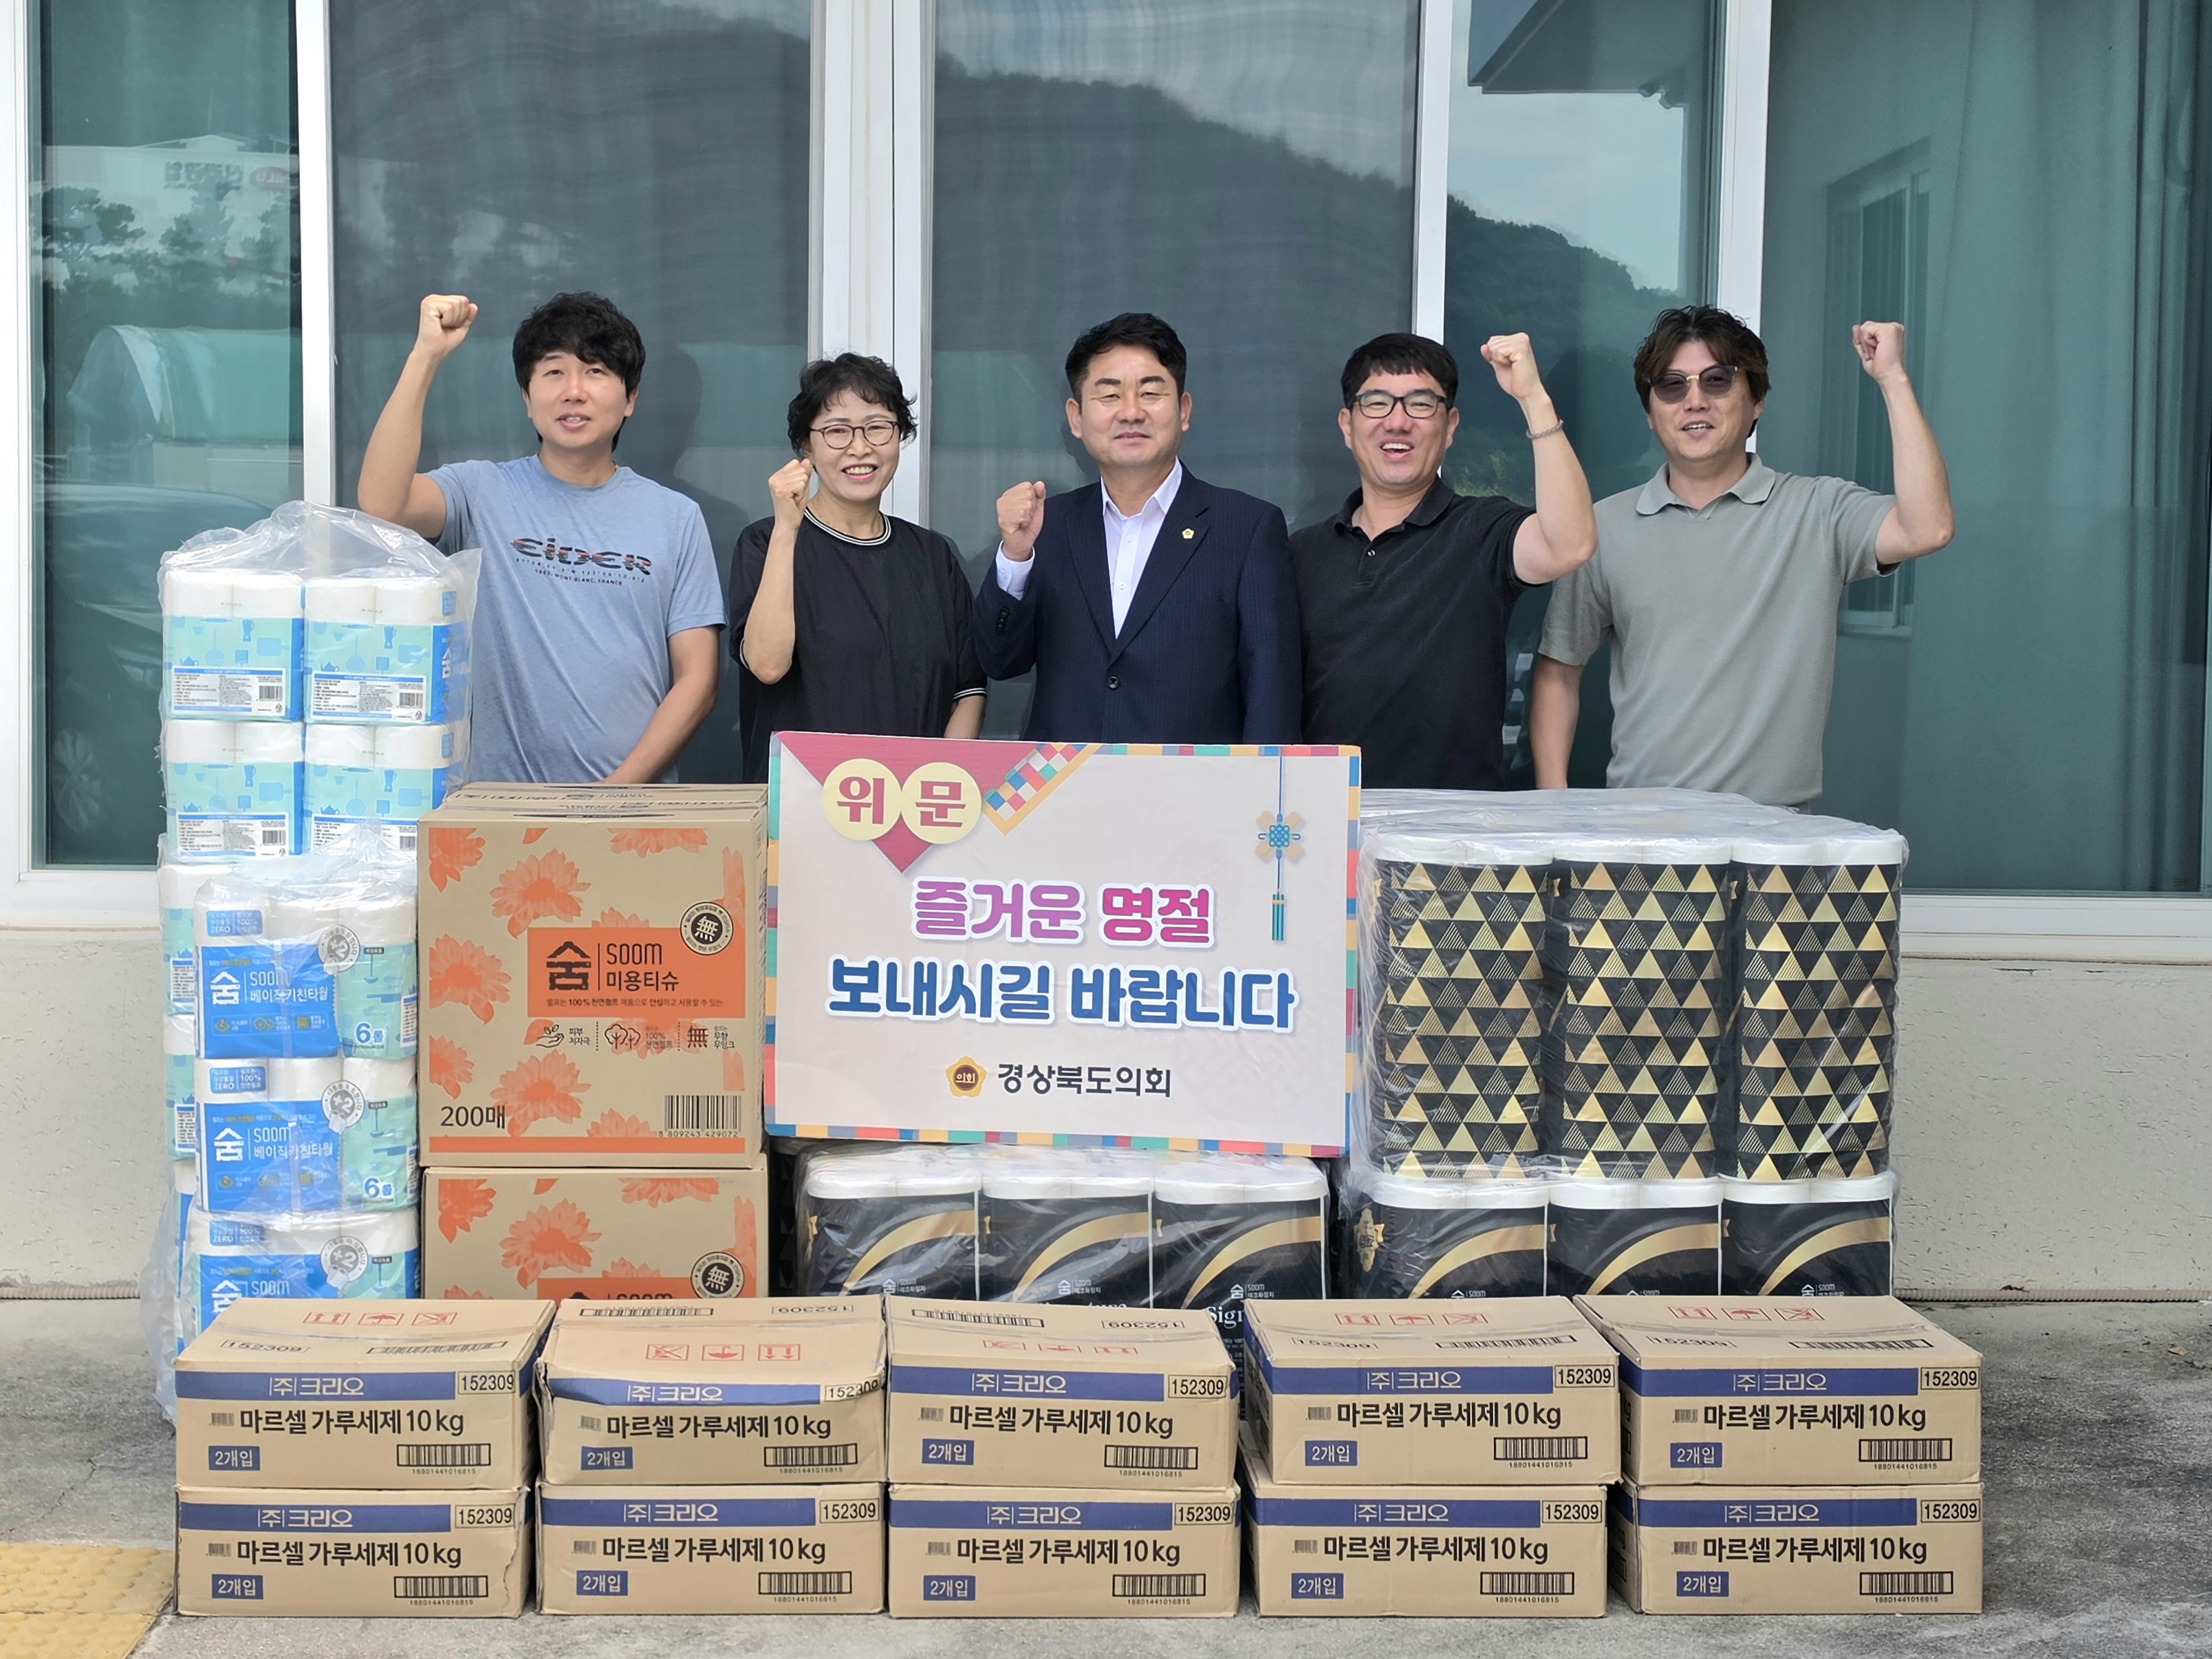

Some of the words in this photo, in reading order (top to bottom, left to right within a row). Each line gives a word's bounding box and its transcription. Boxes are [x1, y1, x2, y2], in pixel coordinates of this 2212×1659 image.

[913, 880, 1083, 940] 즐거운
[1101, 887, 1211, 944] 명절
[546, 941, 592, 990] 숨
[607, 971, 680, 991] 미용티슈
[569, 998, 590, 1007] 100%
[592, 997, 618, 1007] 천연펄프
[650, 998, 676, 1007] 안심하고
[679, 998, 699, 1007] 사용할
[702, 999, 707, 1007] 수
[828, 958, 1051, 1021] 보내시길
[1070, 966, 1296, 1030] 바랍니다
[569, 1028, 584, 1036] 피부
[569, 1037, 590, 1046] 저자극
[713, 1041, 735, 1050] 무잉크
[997, 1063, 1171, 1098] 경상북도의회
[440, 1105, 506, 1130] 200매
[462, 1373, 513, 1391] 152309
[1559, 1369, 1611, 1384] 152309
[1924, 1371, 1977, 1386] 152309
[1173, 1379, 1224, 1395] 152309
[241, 1409, 307, 1434] 마르셀
[312, 1409, 401, 1434] 가루세제
[406, 1409, 463, 1436] 10kg
[951, 1405, 1016, 1431] 마르셀
[1021, 1408, 1111, 1435] 가루세제
[1116, 1411, 1173, 1439] 10kg
[1338, 1402, 1404, 1428] 마르셀
[1409, 1402, 1498, 1427] 가루세제
[1504, 1402, 1561, 1429] 10kg
[1704, 1405, 1770, 1430] 마르셀
[1775, 1404, 1864, 1429] 가루세제
[1869, 1404, 1925, 1431] 10kg
[607, 1416, 674, 1439] 마르셀
[680, 1416, 768, 1438] 가루세제
[774, 1416, 830, 1439] 10kg
[215, 1450, 252, 1467] 2개입
[587, 1451, 625, 1466] 2개입
[929, 1444, 966, 1462] 2개입
[1312, 1445, 1349, 1462] 2개입
[1678, 1446, 1714, 1464] 2개입
[459, 1508, 512, 1524] 152309
[824, 1503, 876, 1519] 152309
[1178, 1507, 1230, 1521] 152309
[1546, 1504, 1598, 1519] 152309
[1924, 1503, 1977, 1519] 152309
[238, 1541, 303, 1565] 마르셀
[309, 1542, 398, 1566] 가루세제
[404, 1543, 461, 1568] 10kg
[603, 1537, 669, 1562] 마르셀
[675, 1538, 763, 1562] 가루세제
[769, 1538, 825, 1564] 10kg
[958, 1539, 1023, 1563] 마르셀
[1029, 1539, 1118, 1564] 가루세제
[1124, 1540, 1180, 1567] 10kg
[1325, 1536, 1391, 1561] 마르셀
[1396, 1537, 1485, 1562] 가루세제
[1491, 1537, 1548, 1565] 10kg
[1704, 1537, 1770, 1563] 마르셀
[1775, 1537, 1865, 1563] 가루세제
[1870, 1537, 1927, 1564] 10kg
[219, 1579, 255, 1596] 2개입
[583, 1574, 620, 1592] 2개입
[931, 1579, 967, 1597] 2개입
[1299, 1577, 1335, 1595] 2개입
[1684, 1576, 1721, 1593] 2개입
